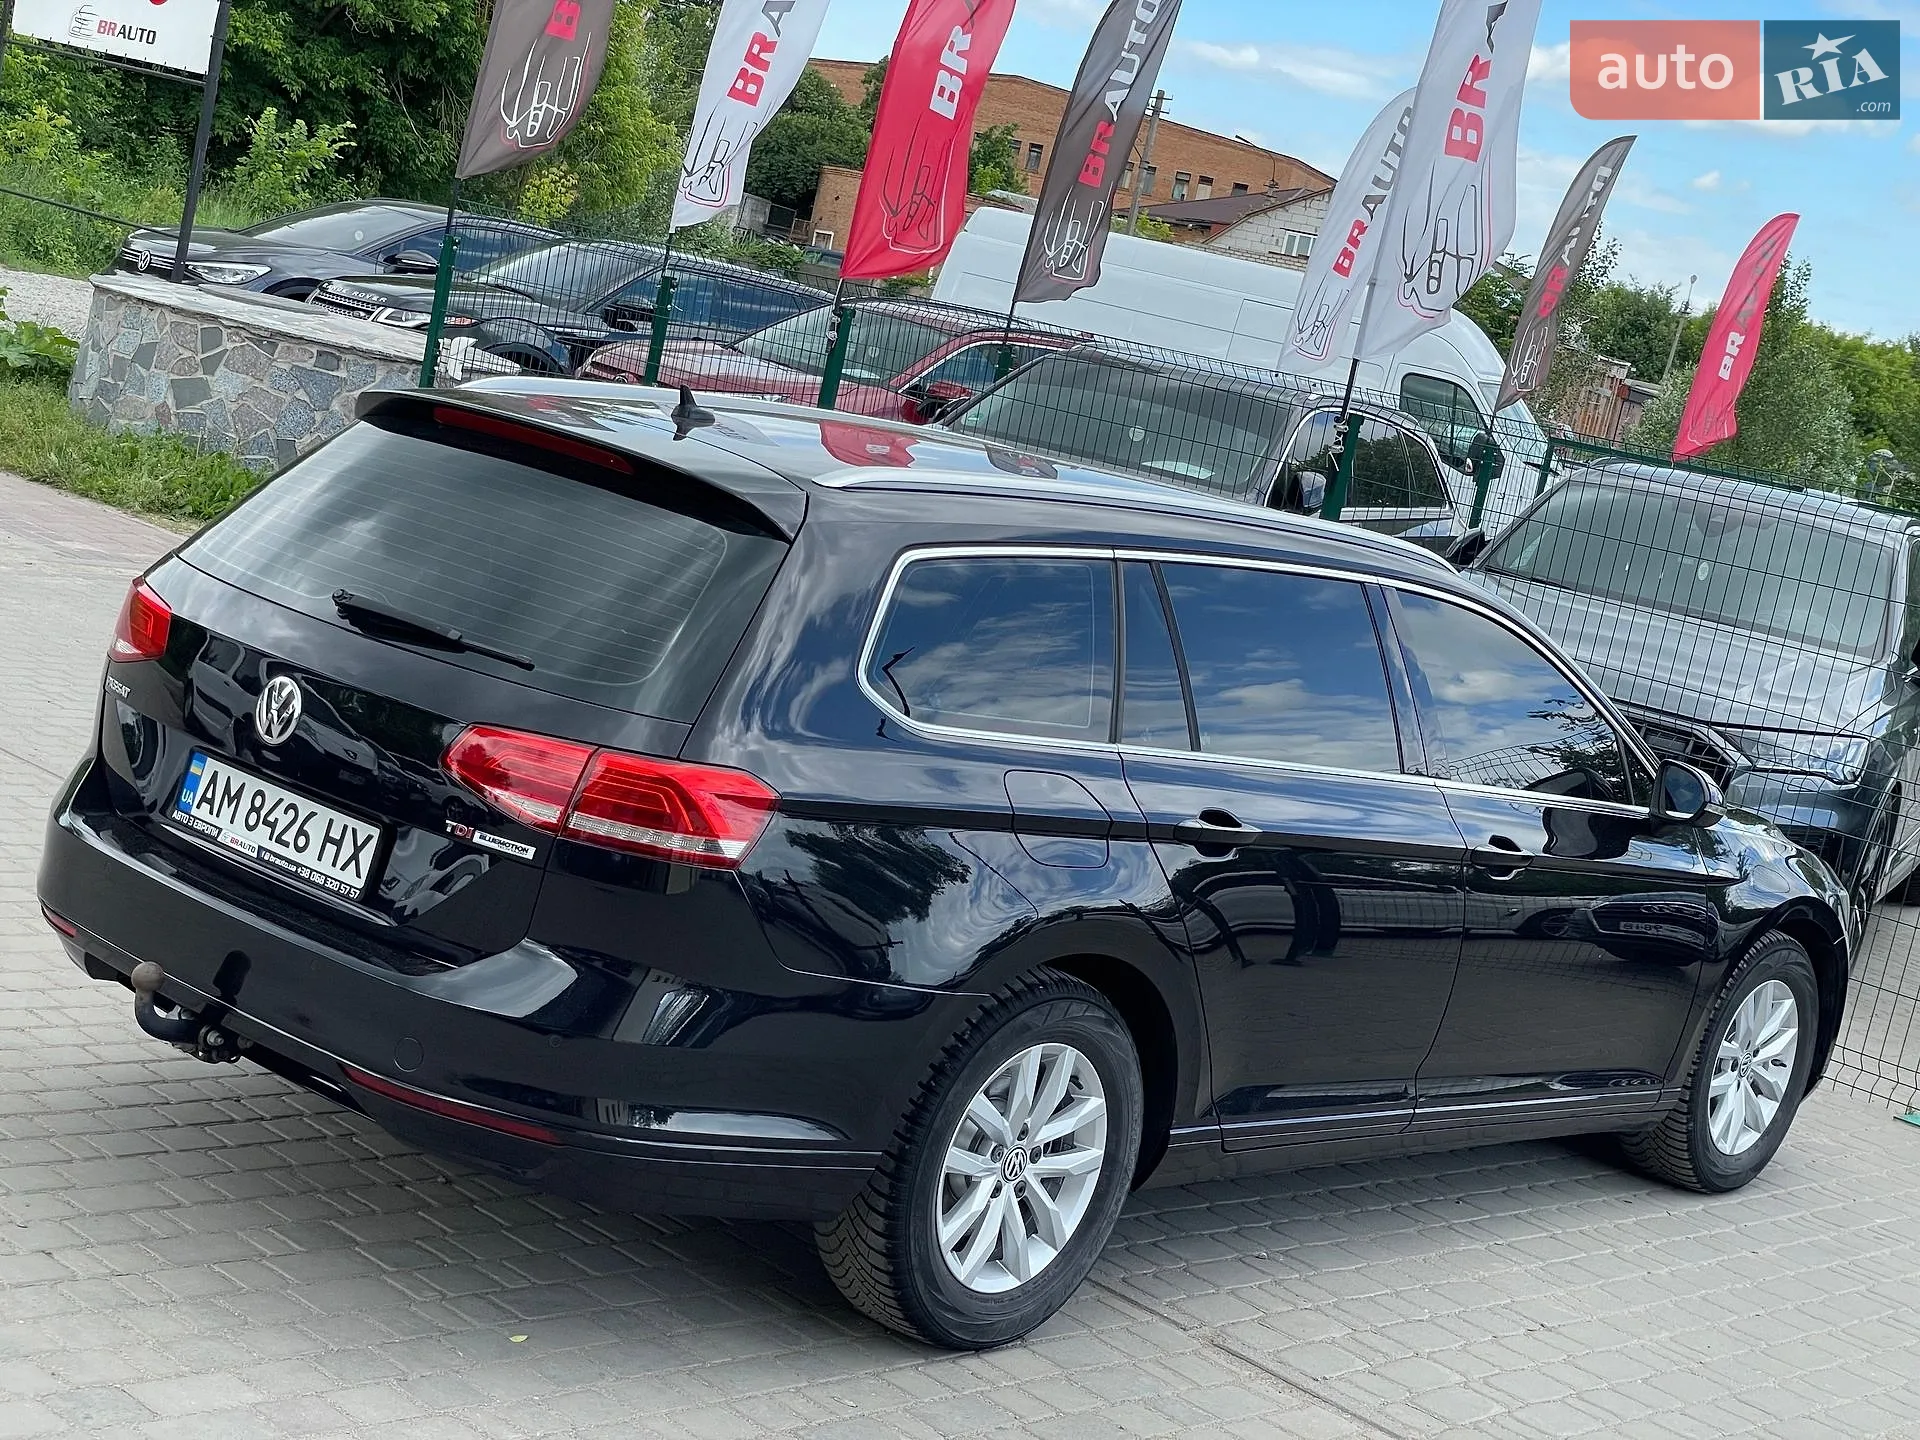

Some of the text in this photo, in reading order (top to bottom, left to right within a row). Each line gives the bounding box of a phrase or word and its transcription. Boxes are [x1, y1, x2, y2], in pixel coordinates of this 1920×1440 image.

[97, 19, 157, 45] BRAUTO
[1078, 0, 1162, 188] BRAUTO
[1332, 106, 1413, 278] BRAUTO
[181, 787, 194, 806] UA
[196, 769, 374, 880] AM 8426 HX
[445, 819, 474, 839] TDI
[229, 836, 257, 854] BRAUTO
[478, 834, 530, 854] BLUEMOTION
[324, 877, 340, 891] 320
[339, 883, 350, 895] 57
[348, 889, 361, 900] 57
